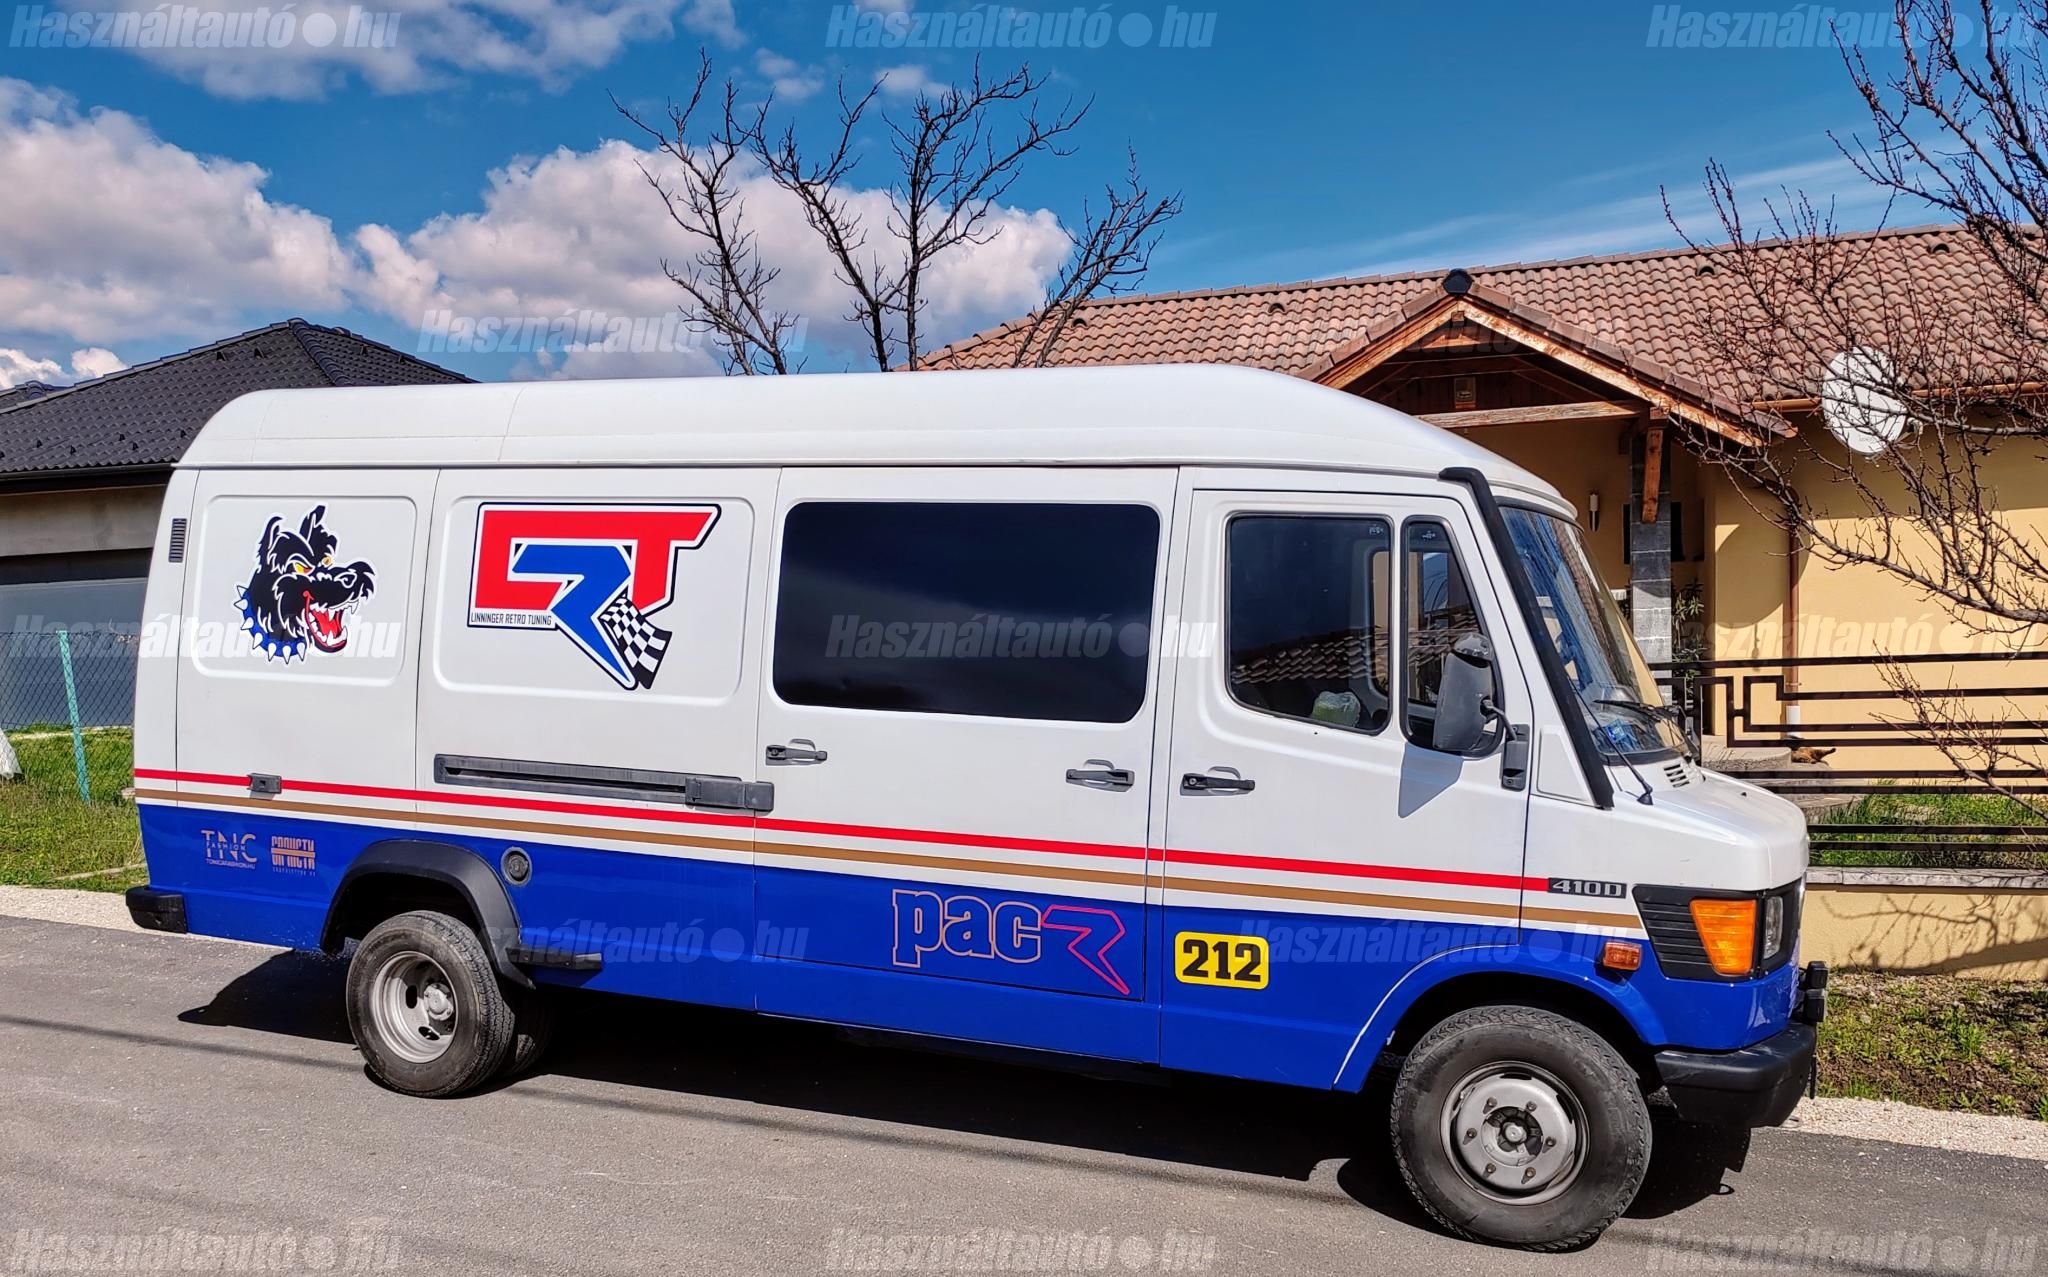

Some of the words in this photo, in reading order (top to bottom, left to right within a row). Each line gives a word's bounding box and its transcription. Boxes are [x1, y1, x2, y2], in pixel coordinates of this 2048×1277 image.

[471, 612, 505, 624] LINNINGER
[505, 613, 527, 625] RETRO
[528, 615, 552, 626] TUNING
[201, 830, 257, 863] TNC
[1551, 879, 1623, 897] 410D
[1181, 938, 1262, 983] 212
